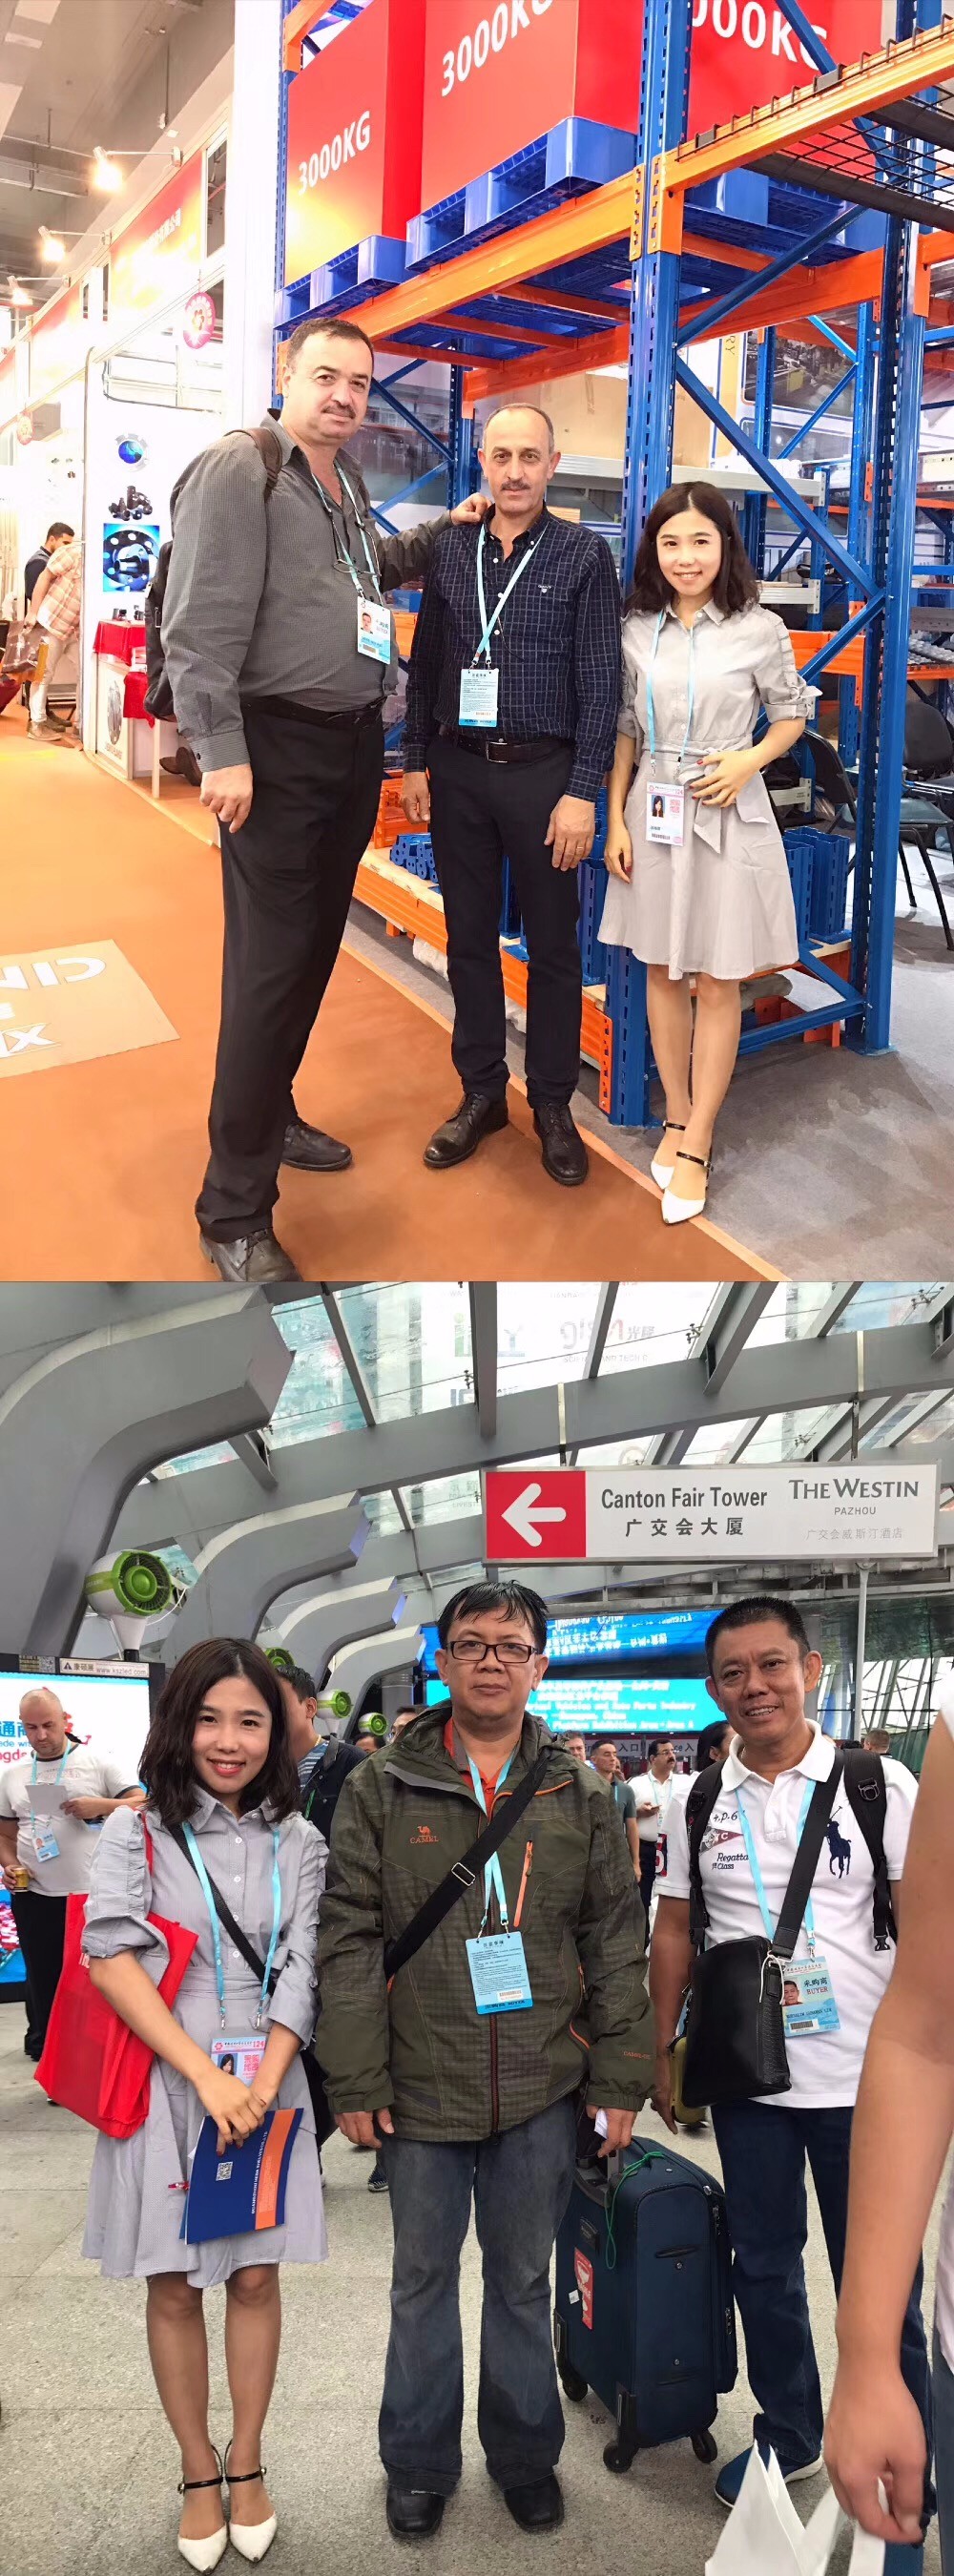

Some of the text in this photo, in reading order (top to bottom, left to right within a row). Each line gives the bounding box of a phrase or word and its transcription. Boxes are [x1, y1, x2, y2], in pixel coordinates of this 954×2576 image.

[298, 110, 371, 197] 3000KG
[789, 1478, 919, 1499] THE WESTIN
[601, 1486, 767, 1508] Canton Fair Tower
[834, 1506, 876, 1515] PAZHOU
[625, 1516, 744, 1537] 广交会大厦
[805, 1527, 902, 1541] 广交会威斯汀酒店
[618, 1739, 639, 1752] 入口
[684, 1739, 695, 1752] 入
[409, 1835, 440, 1844] CAMEL
[716, 1852, 749, 1862] Regatta
[803, 1977, 827, 1987] 采购商
[806, 1986, 828, 1995] BUYER
